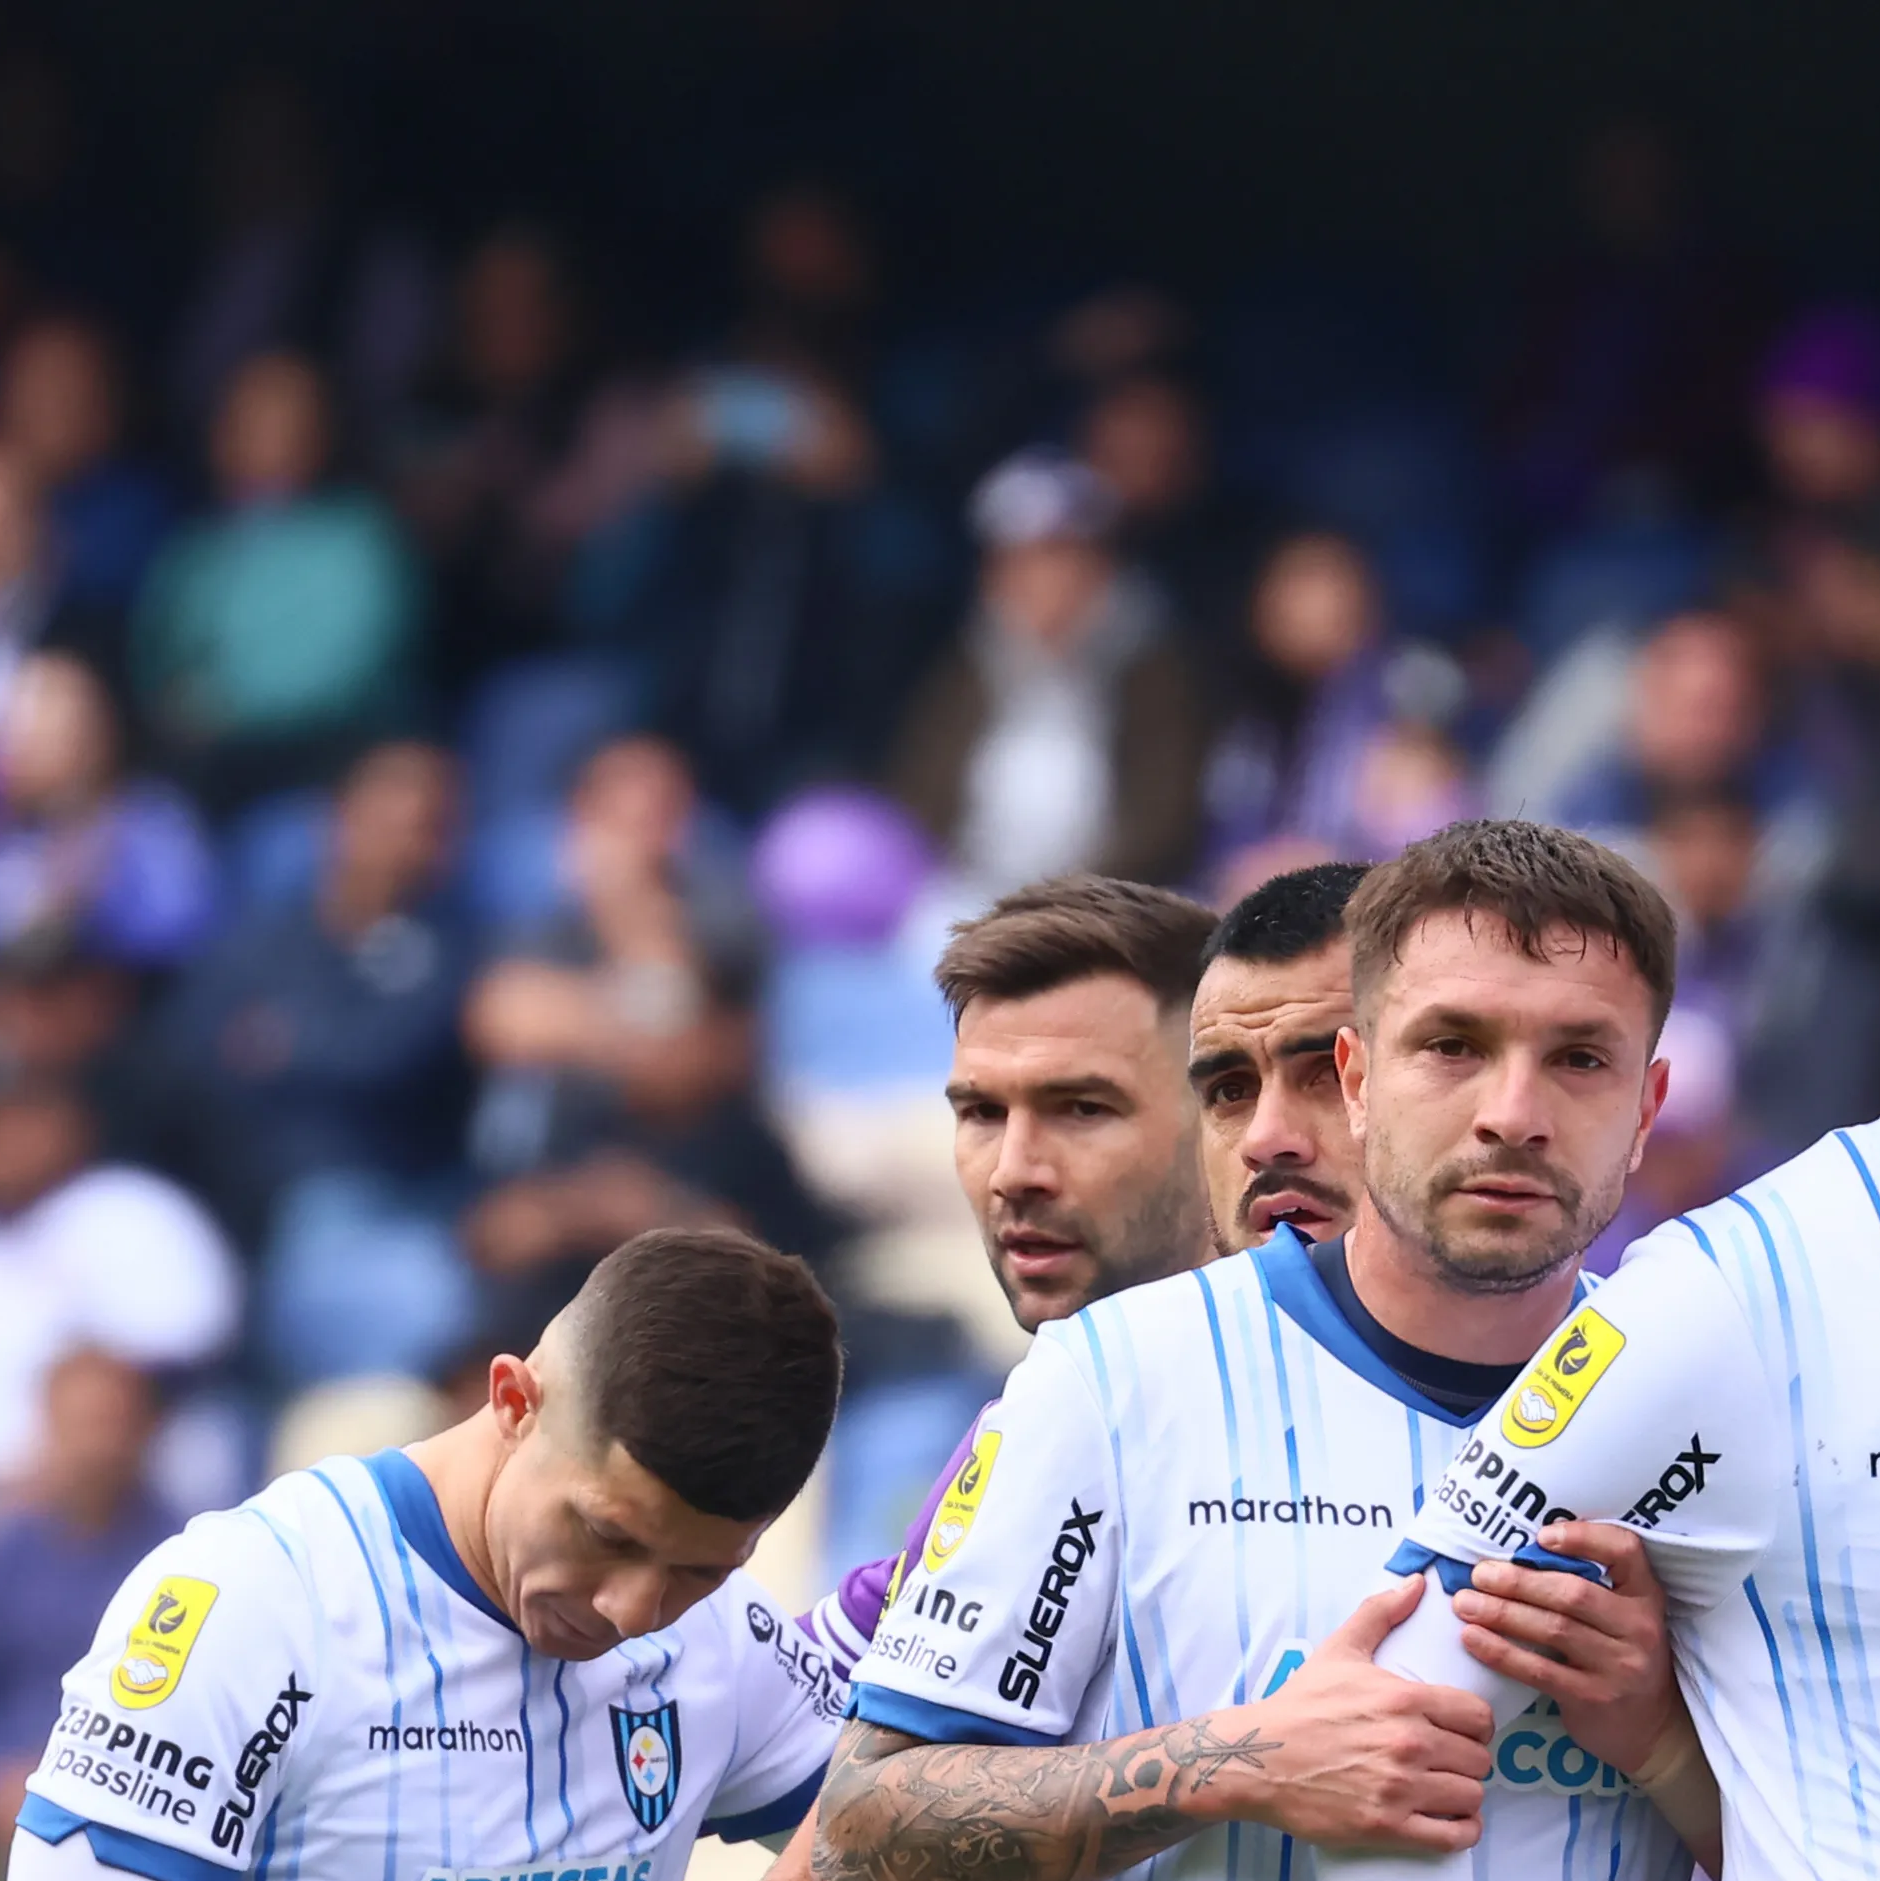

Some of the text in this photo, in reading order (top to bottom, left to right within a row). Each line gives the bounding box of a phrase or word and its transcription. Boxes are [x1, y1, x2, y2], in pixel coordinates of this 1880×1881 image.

[1189, 1494, 1392, 1528] marathon
[998, 1497, 1104, 1710] SUEROX
[211, 1671, 315, 1857] SUEROX
[368, 1719, 523, 1752] marathon
[54, 1746, 197, 1825] passline
